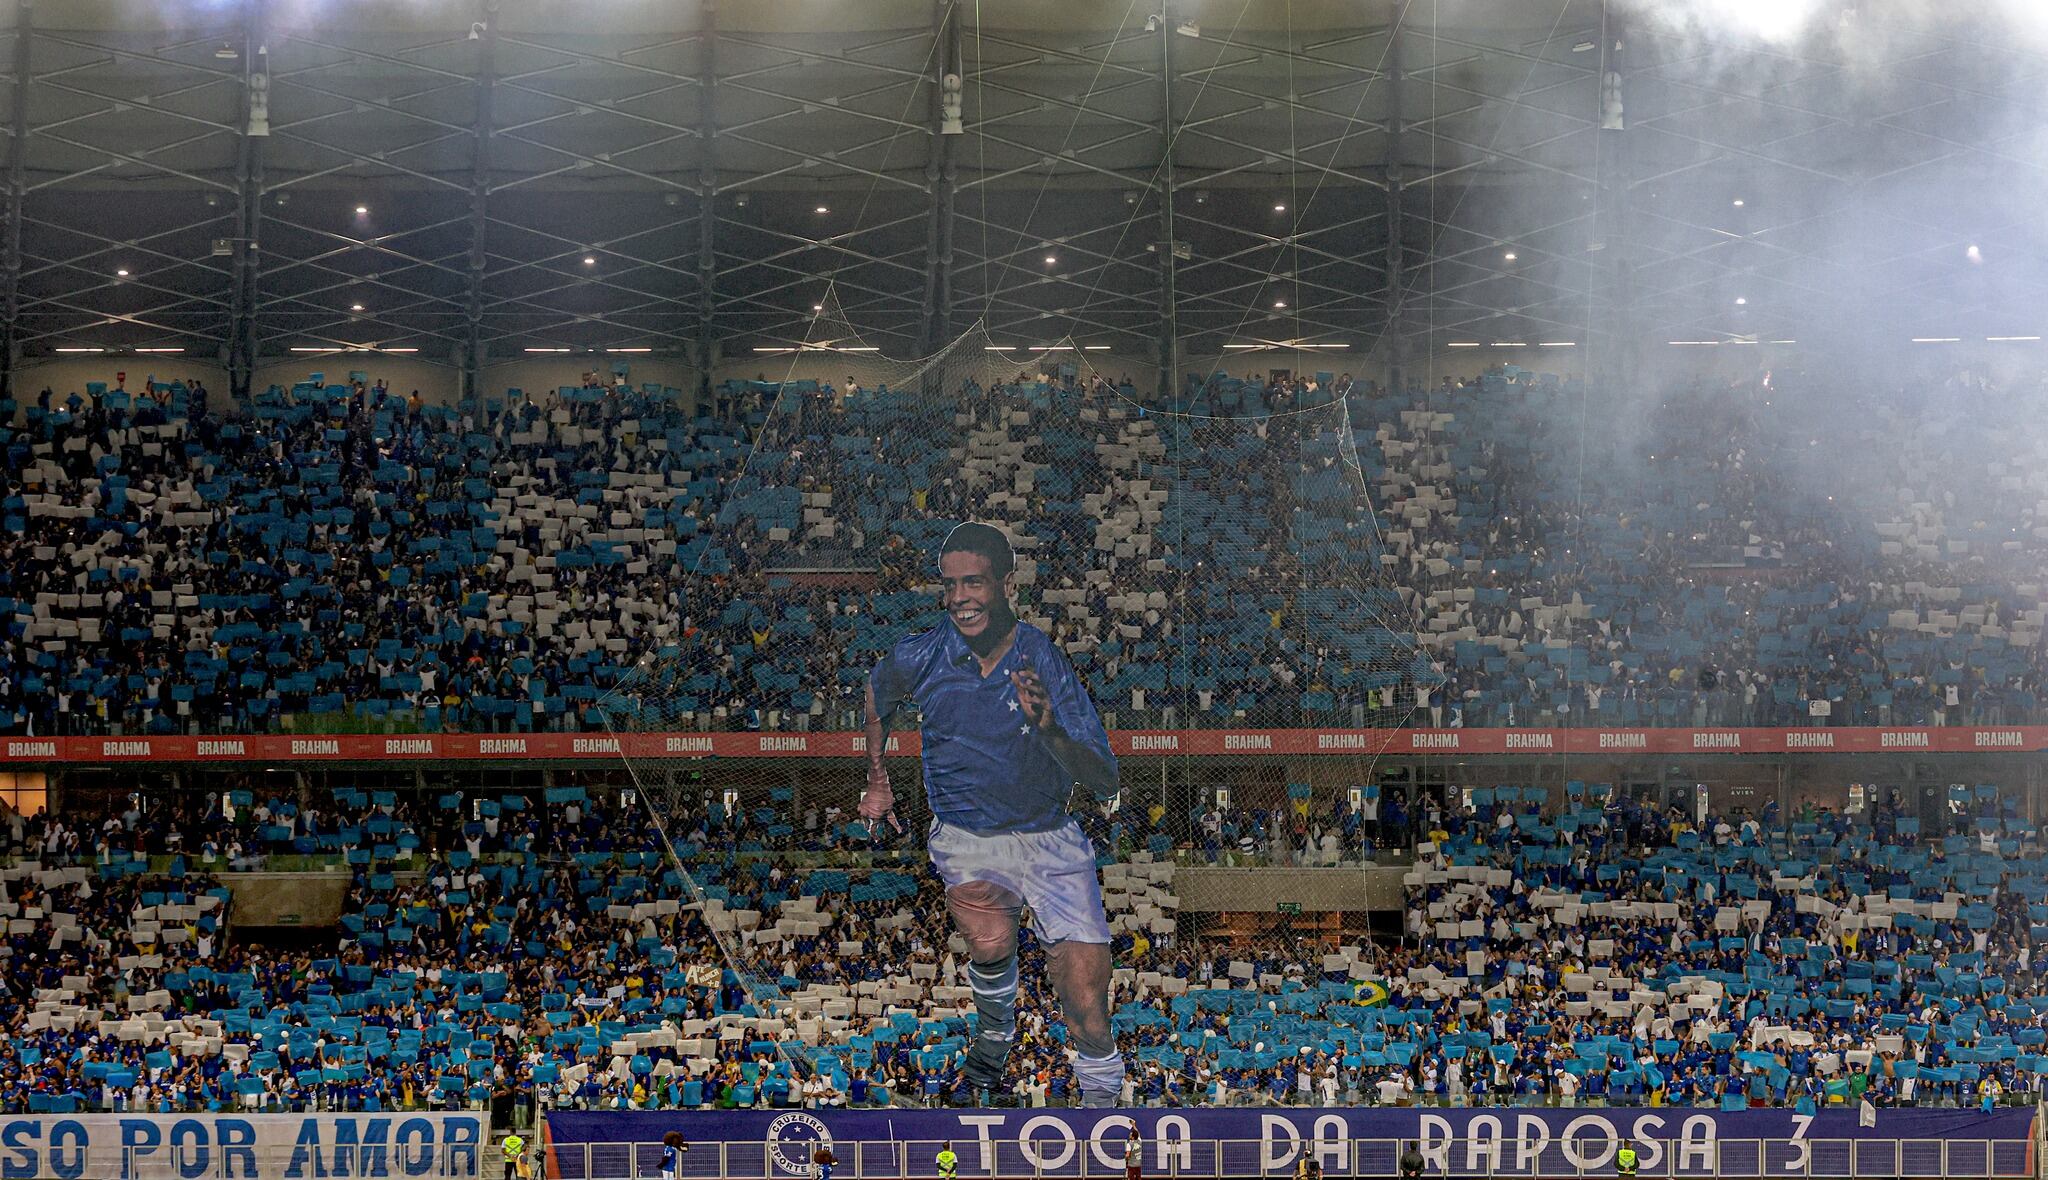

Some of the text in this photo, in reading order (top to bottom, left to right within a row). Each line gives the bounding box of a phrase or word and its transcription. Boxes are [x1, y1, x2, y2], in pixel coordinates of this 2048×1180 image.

[480, 739, 526, 752] BRAHMA
[574, 738, 619, 752] BRAHMA
[667, 738, 712, 751] BRAHMA
[760, 738, 806, 751] BRAHMA
[853, 737, 899, 751] BRMA
[1132, 735, 1178, 749] BRAHMA
[1225, 735, 1271, 748] BRAHMA
[1318, 734, 1364, 748] BRAHMA
[1413, 734, 1458, 747] BRAHMA
[1506, 733, 1552, 747] BRAHMA
[1600, 733, 1646, 747] BRAHMA
[1694, 733, 1740, 747] BRAHMA
[1787, 733, 1833, 746] BRAHMA
[1882, 732, 1928, 746] BRAHMA
[1975, 732, 2022, 746] BRAHMA
[9, 742, 55, 756] BRAHMA
[104, 742, 149, 755] BRAHMA
[198, 741, 244, 754] BRAHMA
[292, 741, 338, 754] BRAHMA
[386, 740, 432, 753] BRAHMA
[772, 1115, 824, 1133] CRUZEIRO
[120, 1119, 258, 1179] POR
[284, 1117, 480, 1178] AMOR
[958, 1113, 1815, 1170] TOCA DA RAPOSA 3
